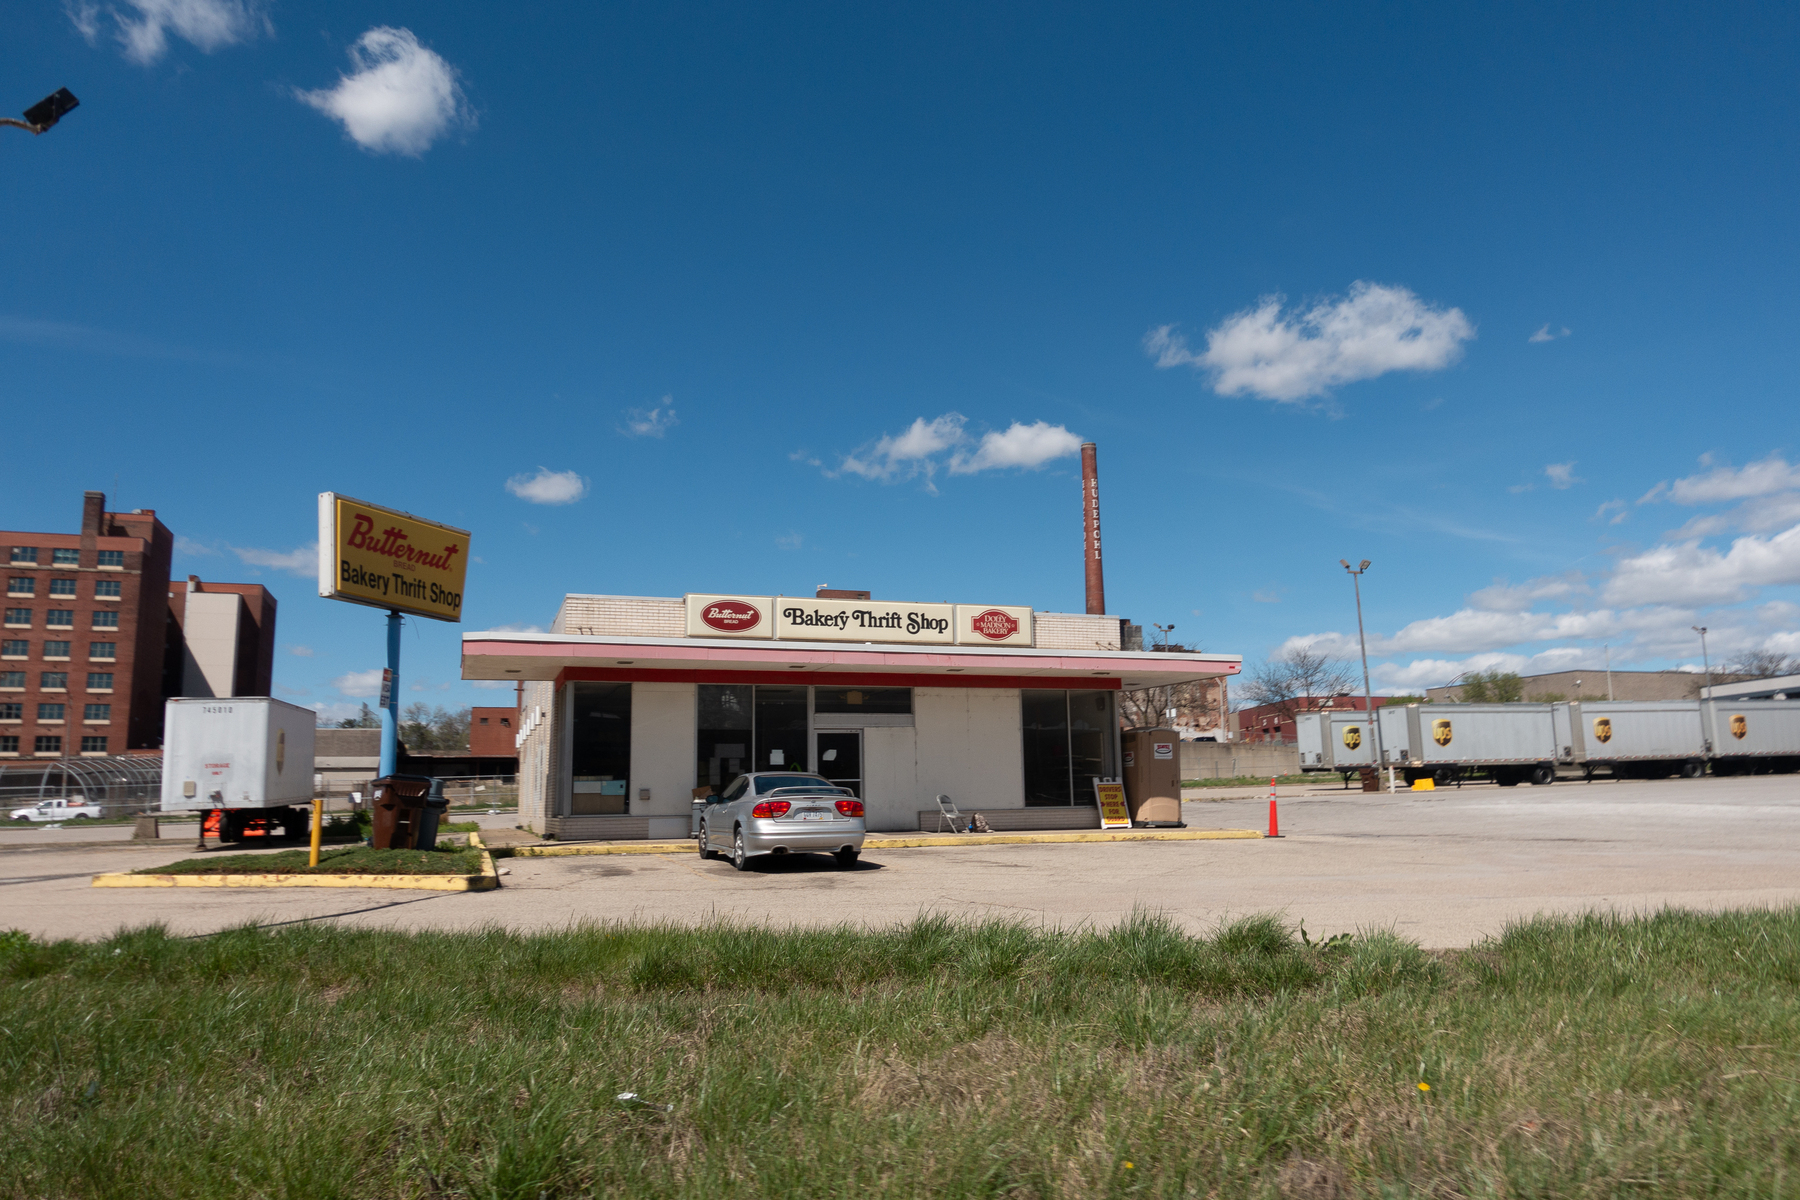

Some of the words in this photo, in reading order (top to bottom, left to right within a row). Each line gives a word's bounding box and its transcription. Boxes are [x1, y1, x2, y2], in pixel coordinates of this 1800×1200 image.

[1091, 478, 1101, 560] HUDEPOHL
[347, 513, 459, 571] Butternut
[393, 560, 416, 572] BREAD
[341, 560, 390, 596] Bakery
[392, 572, 427, 600] Thrift
[429, 582, 461, 611] Shop
[708, 607, 755, 620] Butternut
[783, 607, 849, 630] Bakery
[852, 609, 902, 629] Thrift
[906, 611, 948, 635] Shop
[980, 621, 1011, 629] MADISON
[983, 627, 1008, 635] BAKERY
